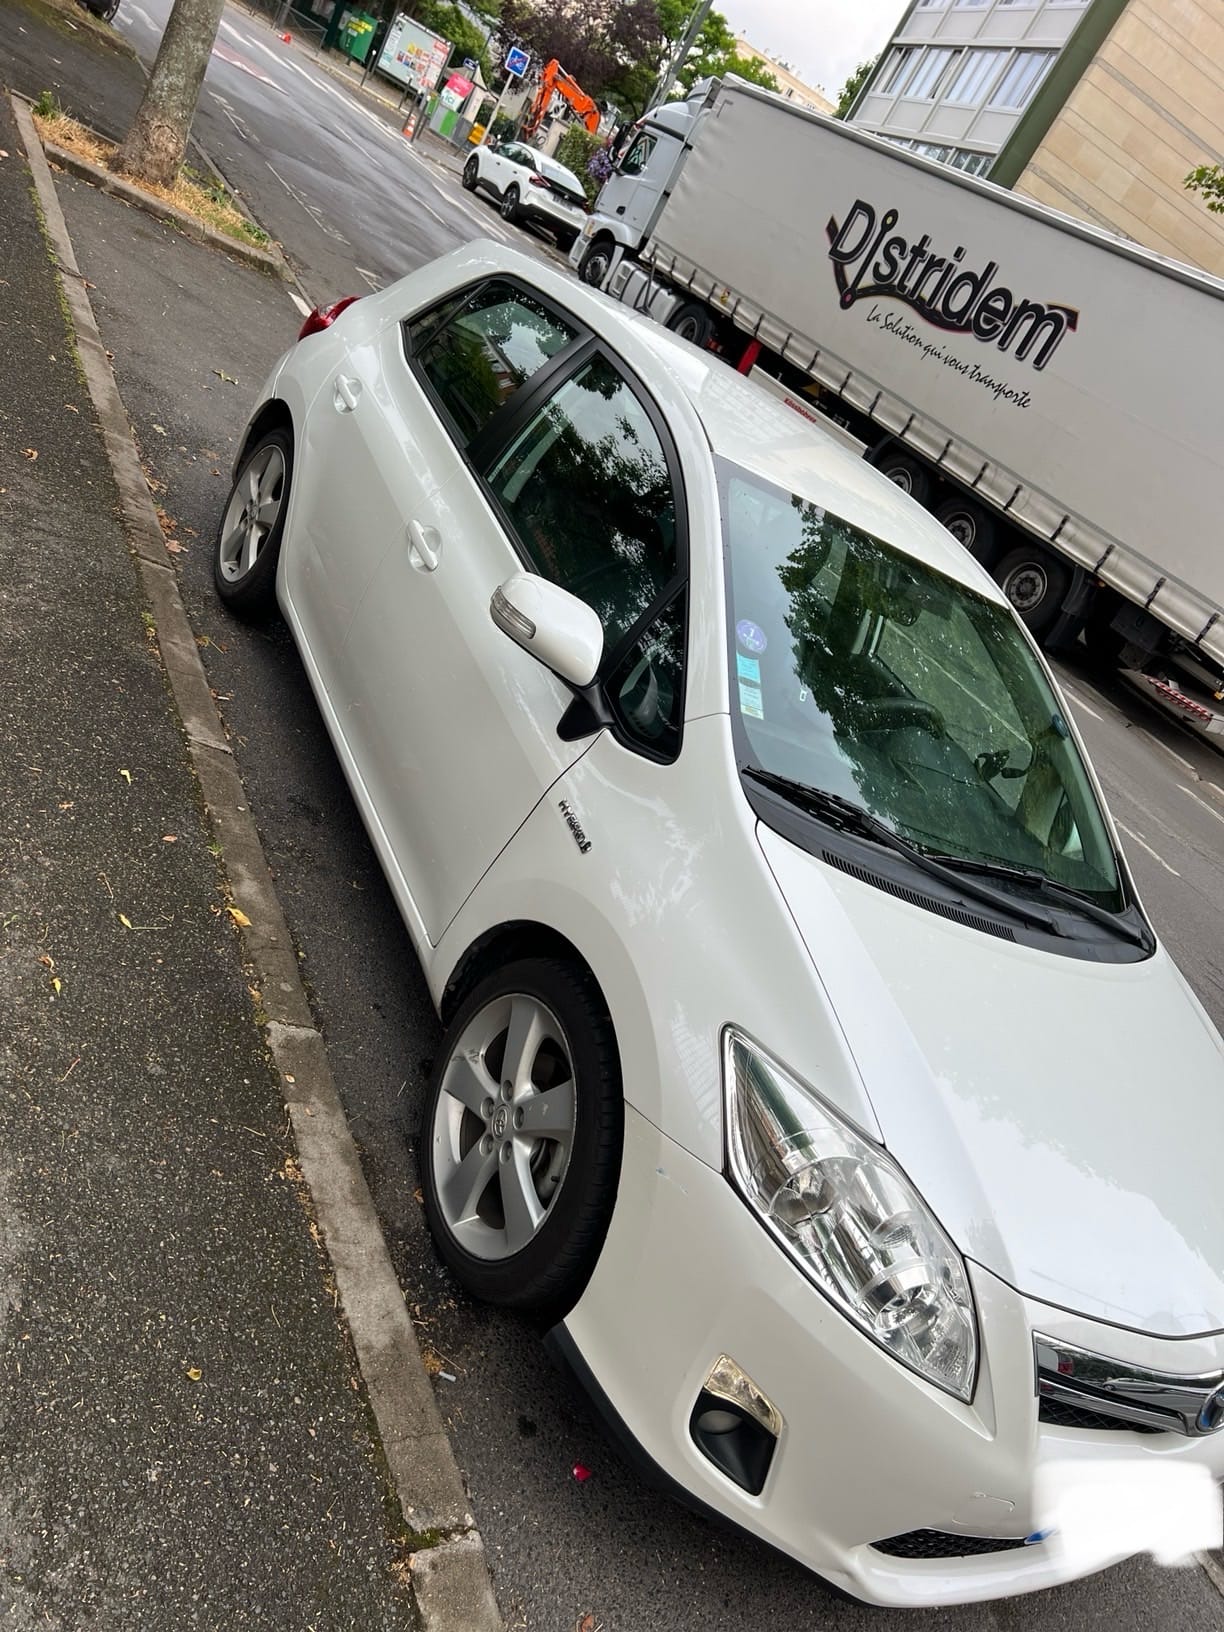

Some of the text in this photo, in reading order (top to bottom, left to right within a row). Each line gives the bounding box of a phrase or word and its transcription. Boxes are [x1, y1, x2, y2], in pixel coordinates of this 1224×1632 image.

[828, 199, 1069, 370] Distridem
[866, 304, 1031, 409] La Solution qui vous transporte
